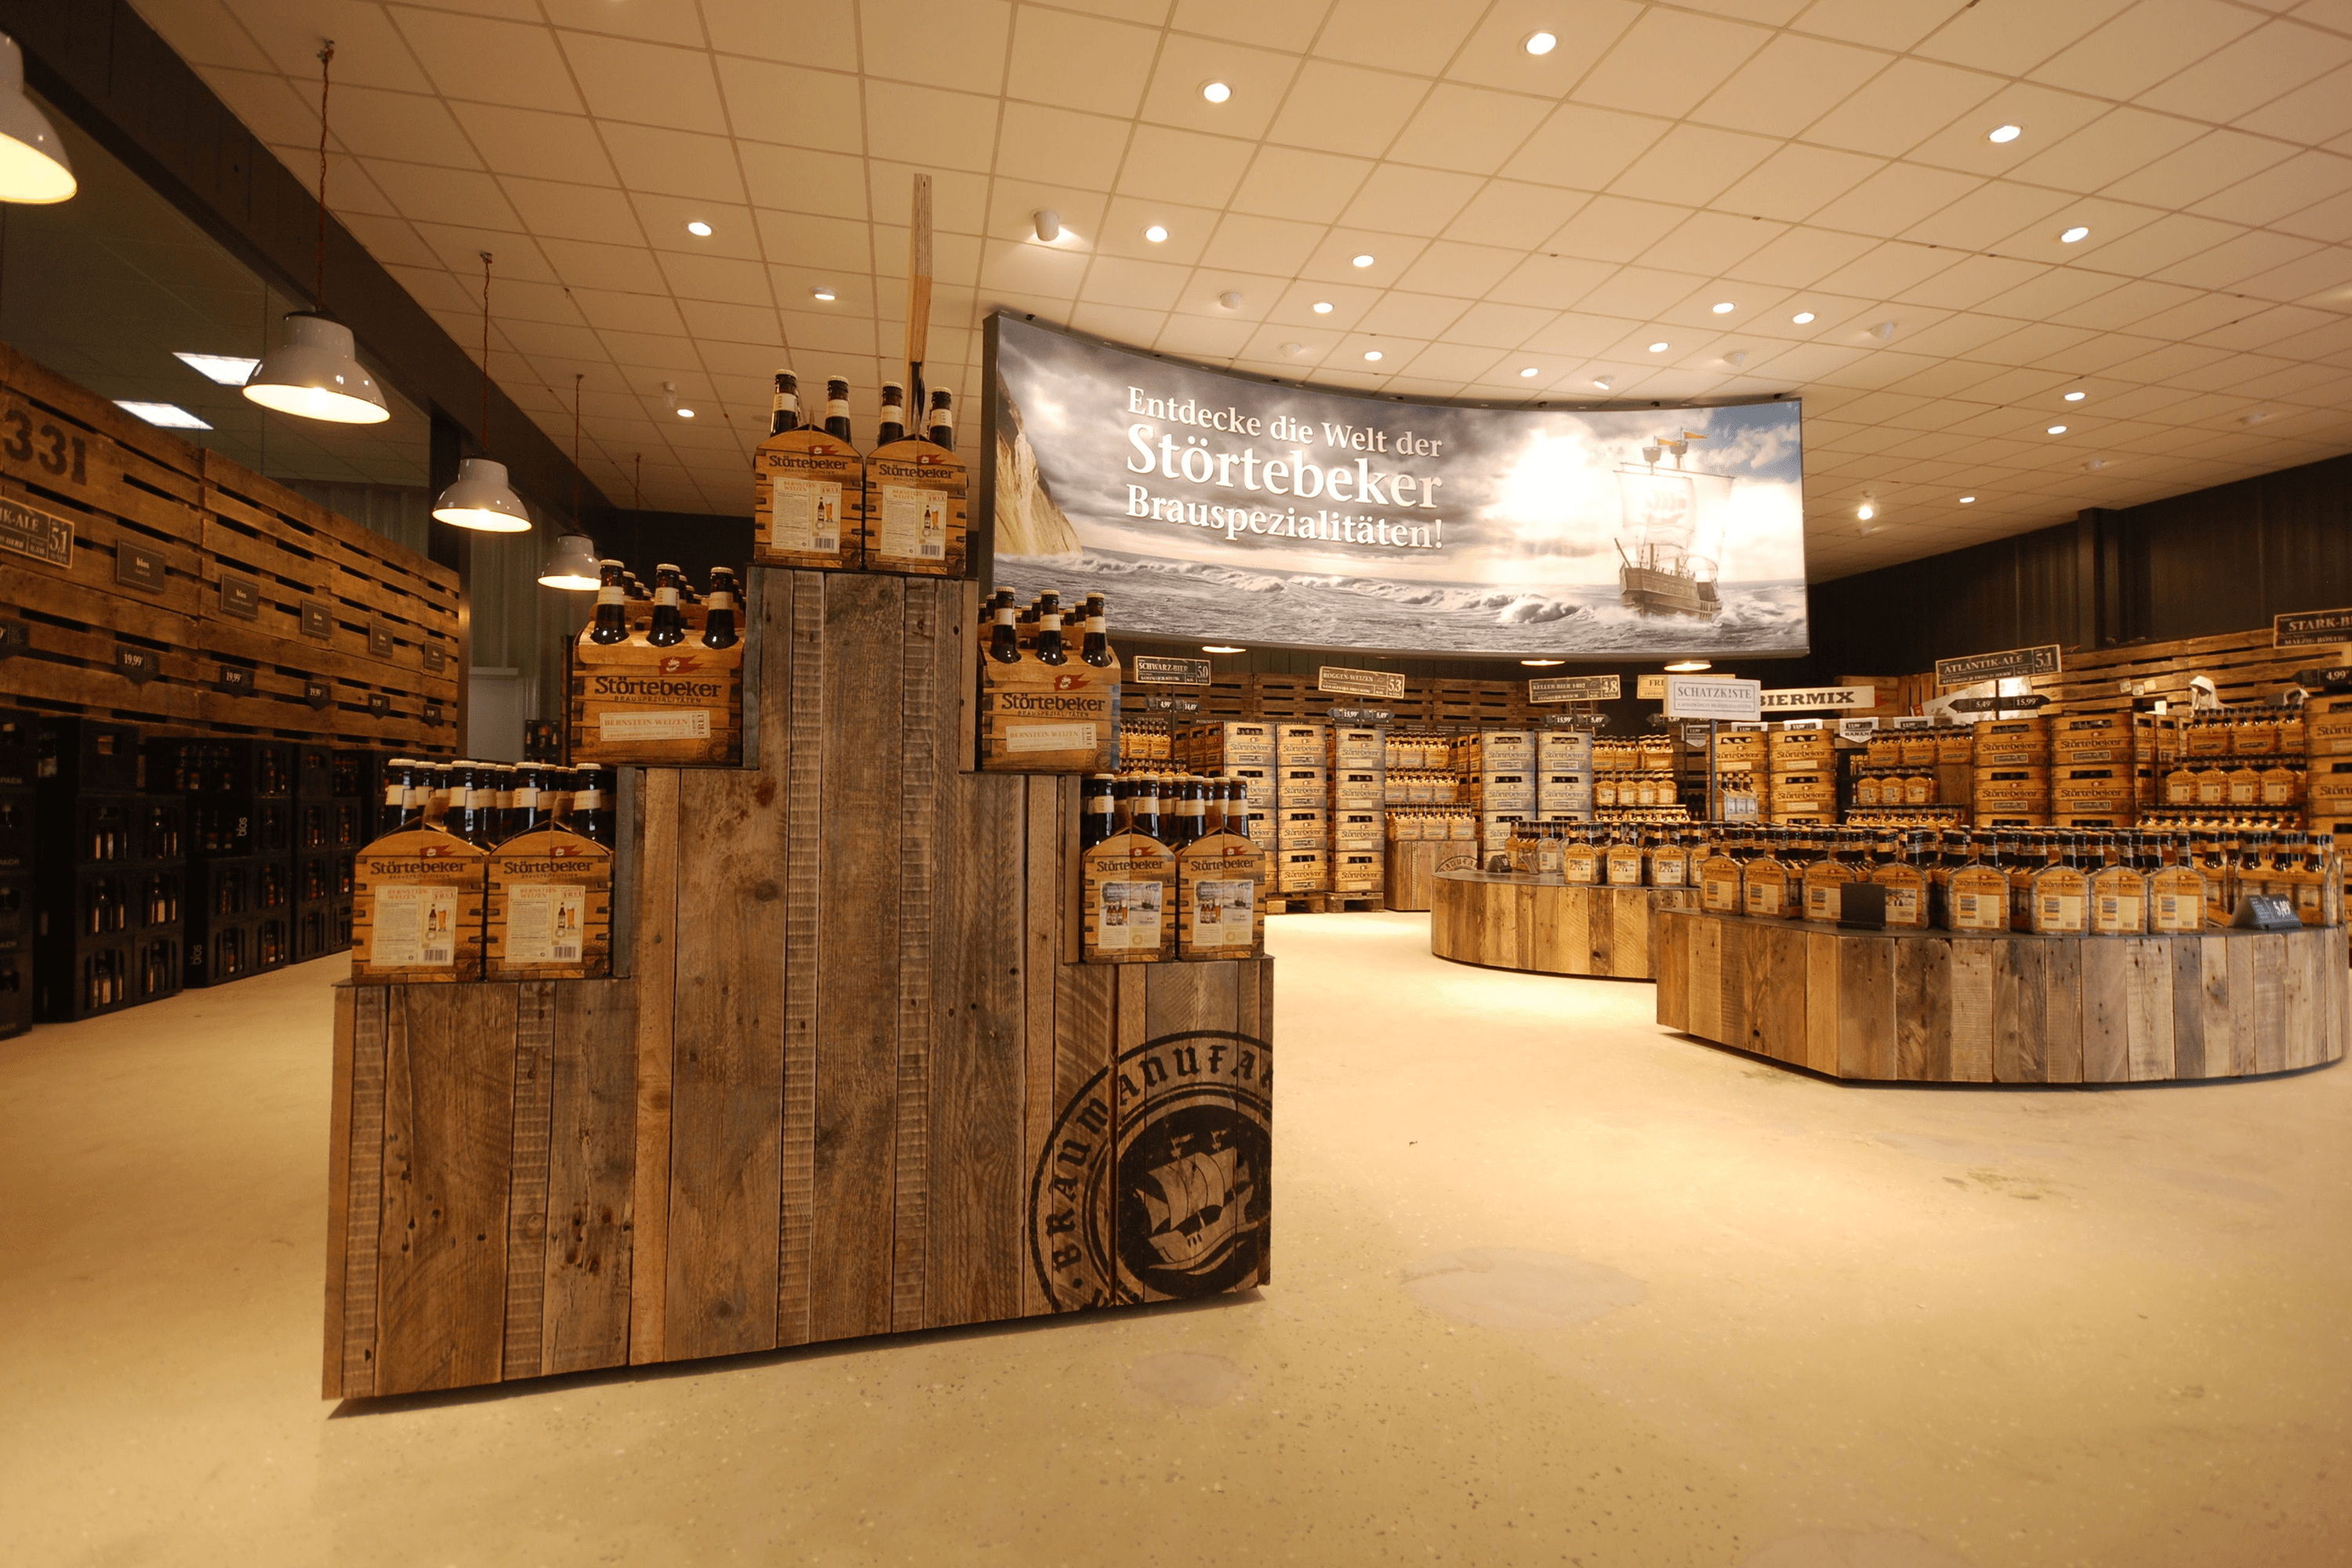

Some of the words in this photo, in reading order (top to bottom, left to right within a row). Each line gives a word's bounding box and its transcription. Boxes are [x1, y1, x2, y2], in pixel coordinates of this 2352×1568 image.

[1127, 385, 1261, 437] Entdecke
[1270, 416, 1313, 445] die
[1321, 421, 1387, 453] Welt
[1396, 431, 1443, 457] der
[768, 455, 848, 470] Störtebeker
[1127, 423, 1443, 509] Störtebeker
[879, 463, 954, 479] Störtebeker
[1126, 483, 1443, 549] Brauspezialitäten!
[136, 557, 150, 569] bios
[1138, 662, 1189, 672] SCHWARZ-BIER
[1944, 654, 2024, 674] ATLANTIK-ALE
[2034, 652, 2054, 668] 5,1
[1323, 672, 1374, 682] ROGGEN-WEIZEN
[594, 676, 722, 697] Störtebeker
[1001, 693, 1105, 711] Störtebeker
[1760, 691, 1855, 706] BIERMIX
[1983, 743, 2037, 752] Störtebeker
[2060, 739, 2122, 750] Störtebeker
[1777, 750, 1826, 759] Störtebeker
[1983, 789, 2037, 798] Störtebeker
[2061, 789, 2122, 798] Störtebeker
[236, 817, 248, 837] bios
[370, 861, 467, 875] Störtebeker
[503, 861, 593, 875] Störtebeker
[1096, 860, 1165, 873] Störtebeker
[1190, 859, 1256, 873] Störtebeker
[1285, 870, 1322, 879] Störtebeker
[2041, 880, 2083, 889] Störtebeker
[2098, 881, 2141, 890] Störtebeker
[2157, 880, 2200, 889] Störtebeker
[191, 944, 202, 965] bios
